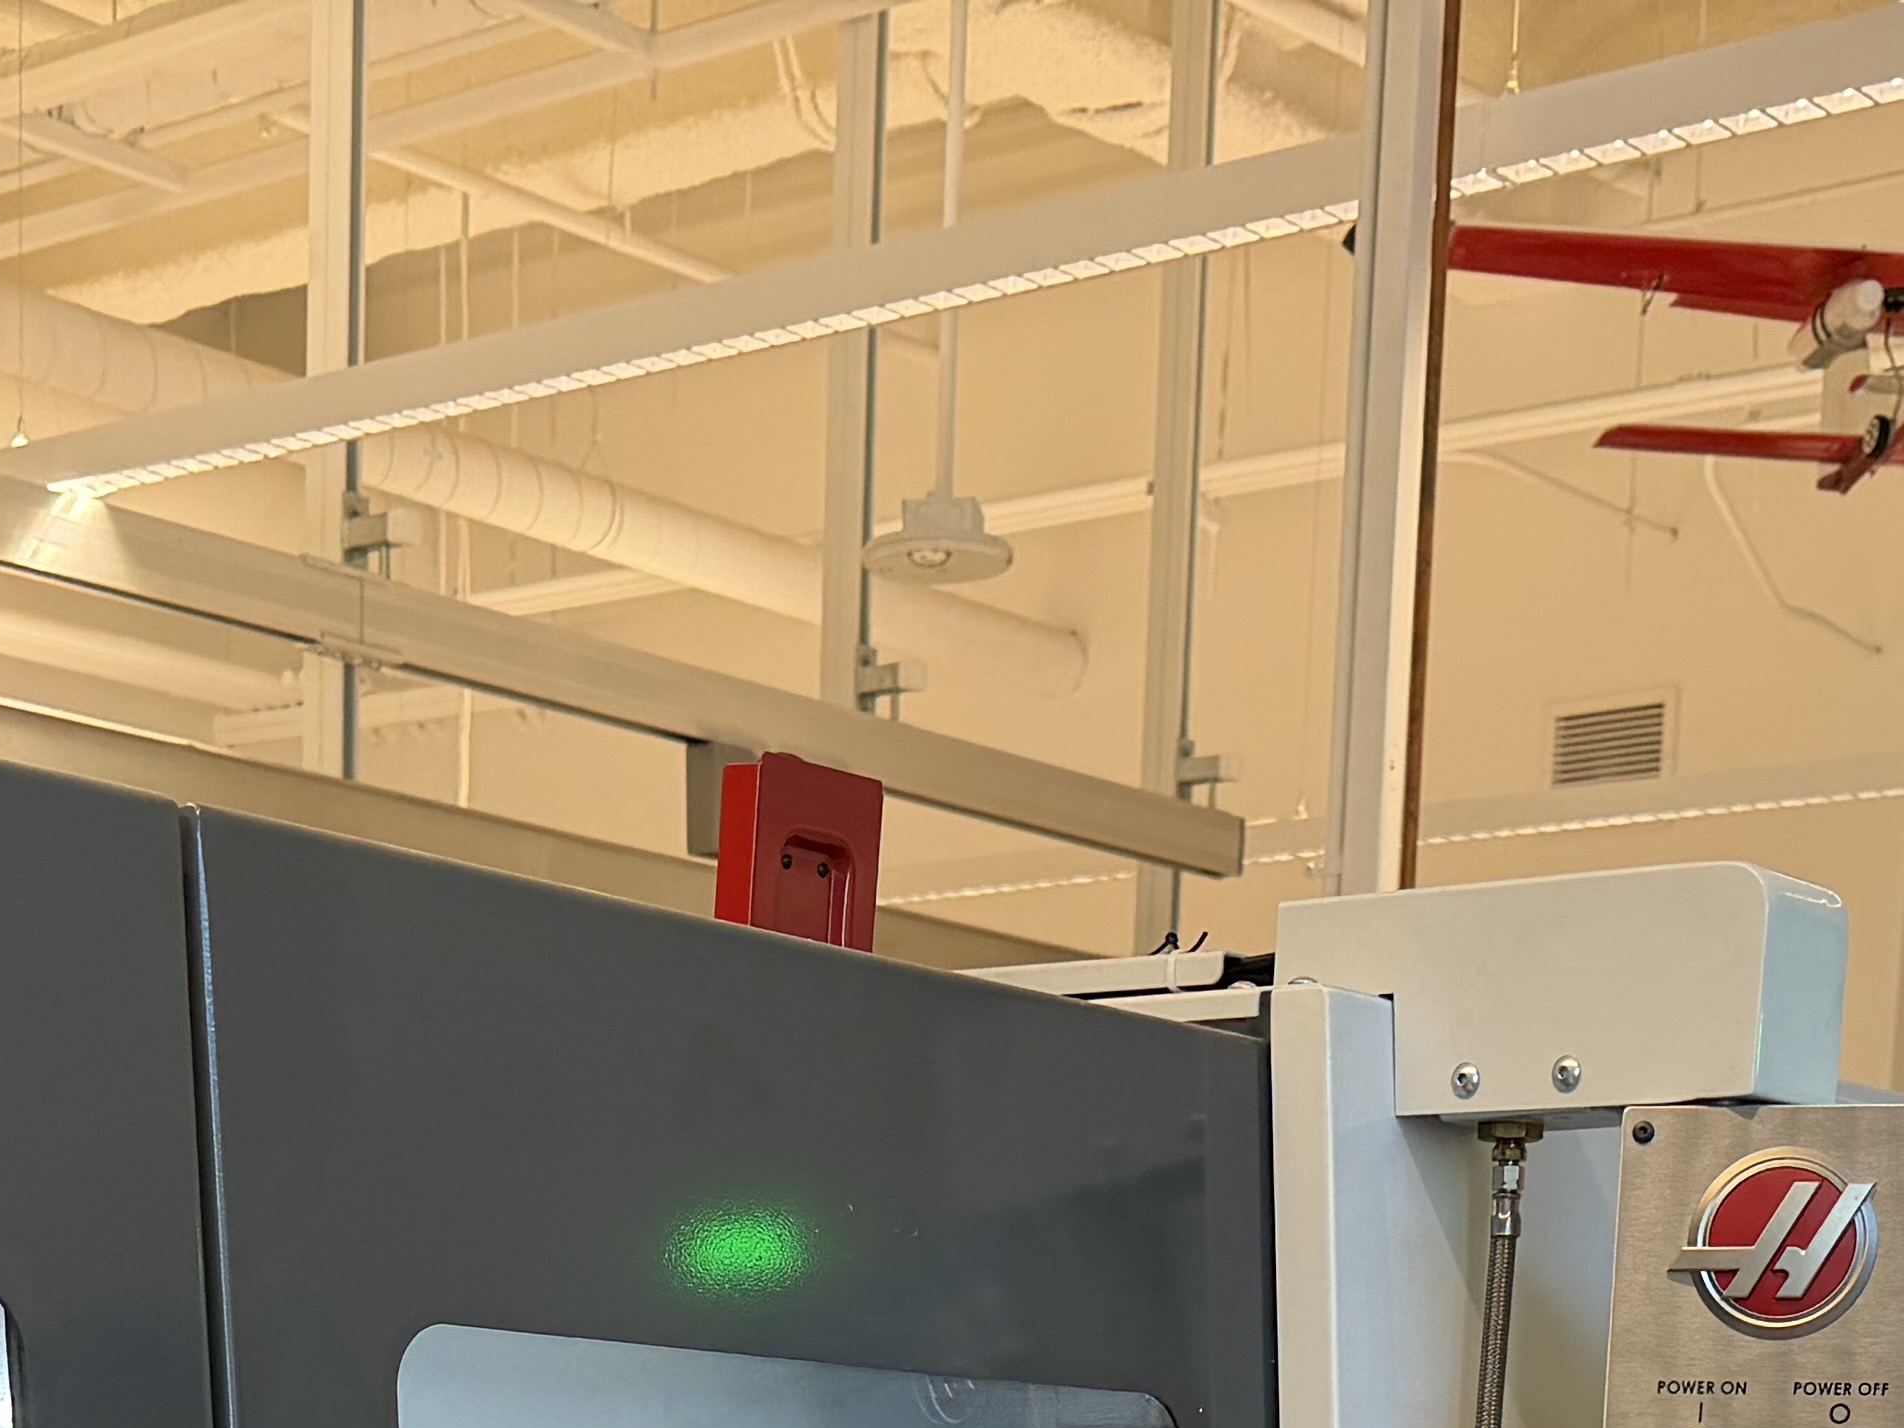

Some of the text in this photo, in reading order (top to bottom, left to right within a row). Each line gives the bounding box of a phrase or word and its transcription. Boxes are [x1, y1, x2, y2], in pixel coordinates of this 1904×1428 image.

[1657, 1380, 1747, 1395] POWER ON
[1793, 1382, 1889, 1397] POWER OFF
